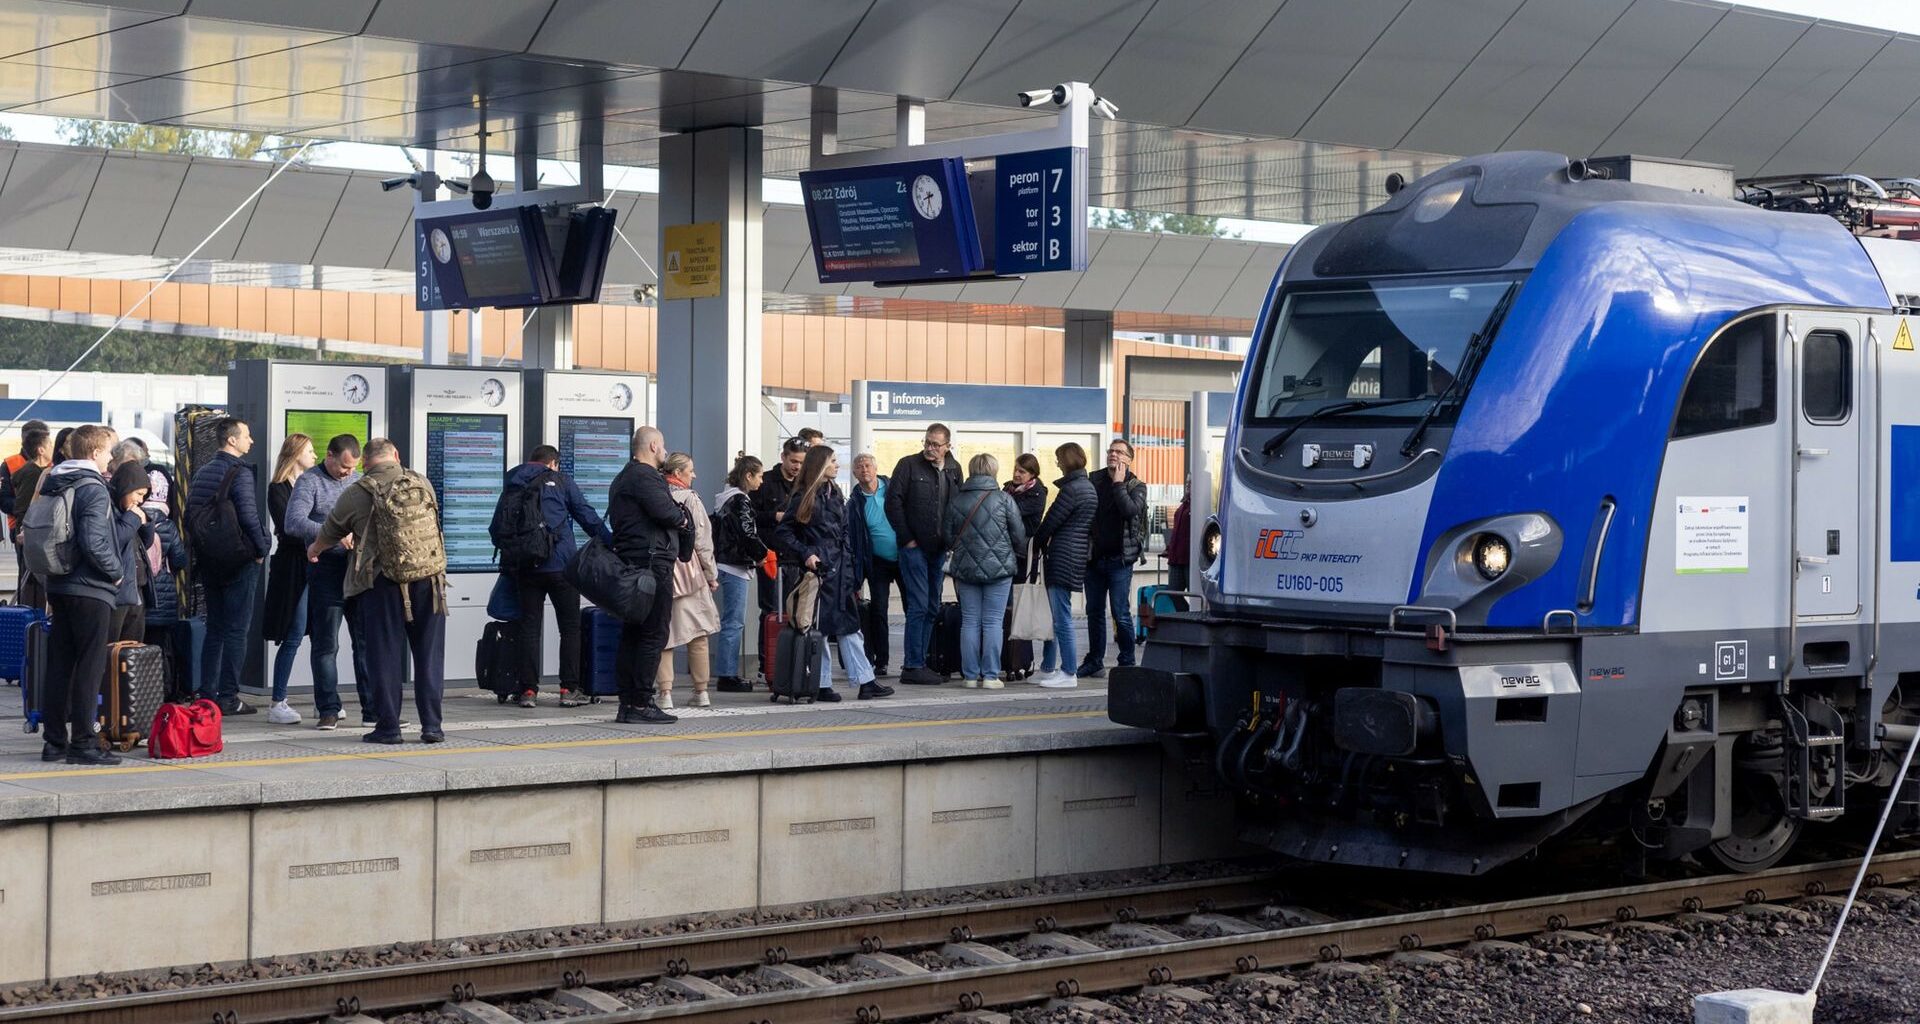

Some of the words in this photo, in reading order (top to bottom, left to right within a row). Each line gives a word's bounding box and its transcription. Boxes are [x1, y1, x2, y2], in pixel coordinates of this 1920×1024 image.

[1009, 172, 1039, 188] peron
[1051, 168, 1063, 193] 7
[834, 186, 857, 201] Zdrój
[1018, 187, 1039, 197] platform
[1026, 208, 1039, 218] tor
[1051, 205, 1061, 226] 3
[420, 234, 427, 252] 7
[1012, 240, 1038, 253] sektor
[1049, 238, 1060, 260] B
[421, 262, 428, 277] 5
[421, 286, 429, 302] B
[1349, 376, 1380, 396] dnia
[892, 392, 945, 408] informacja
[1301, 553, 1317, 562] PKP
[1319, 553, 1363, 564] INTERCITY
[1277, 574, 1343, 593] EU160-005
[1824, 577, 1829, 592] 1
